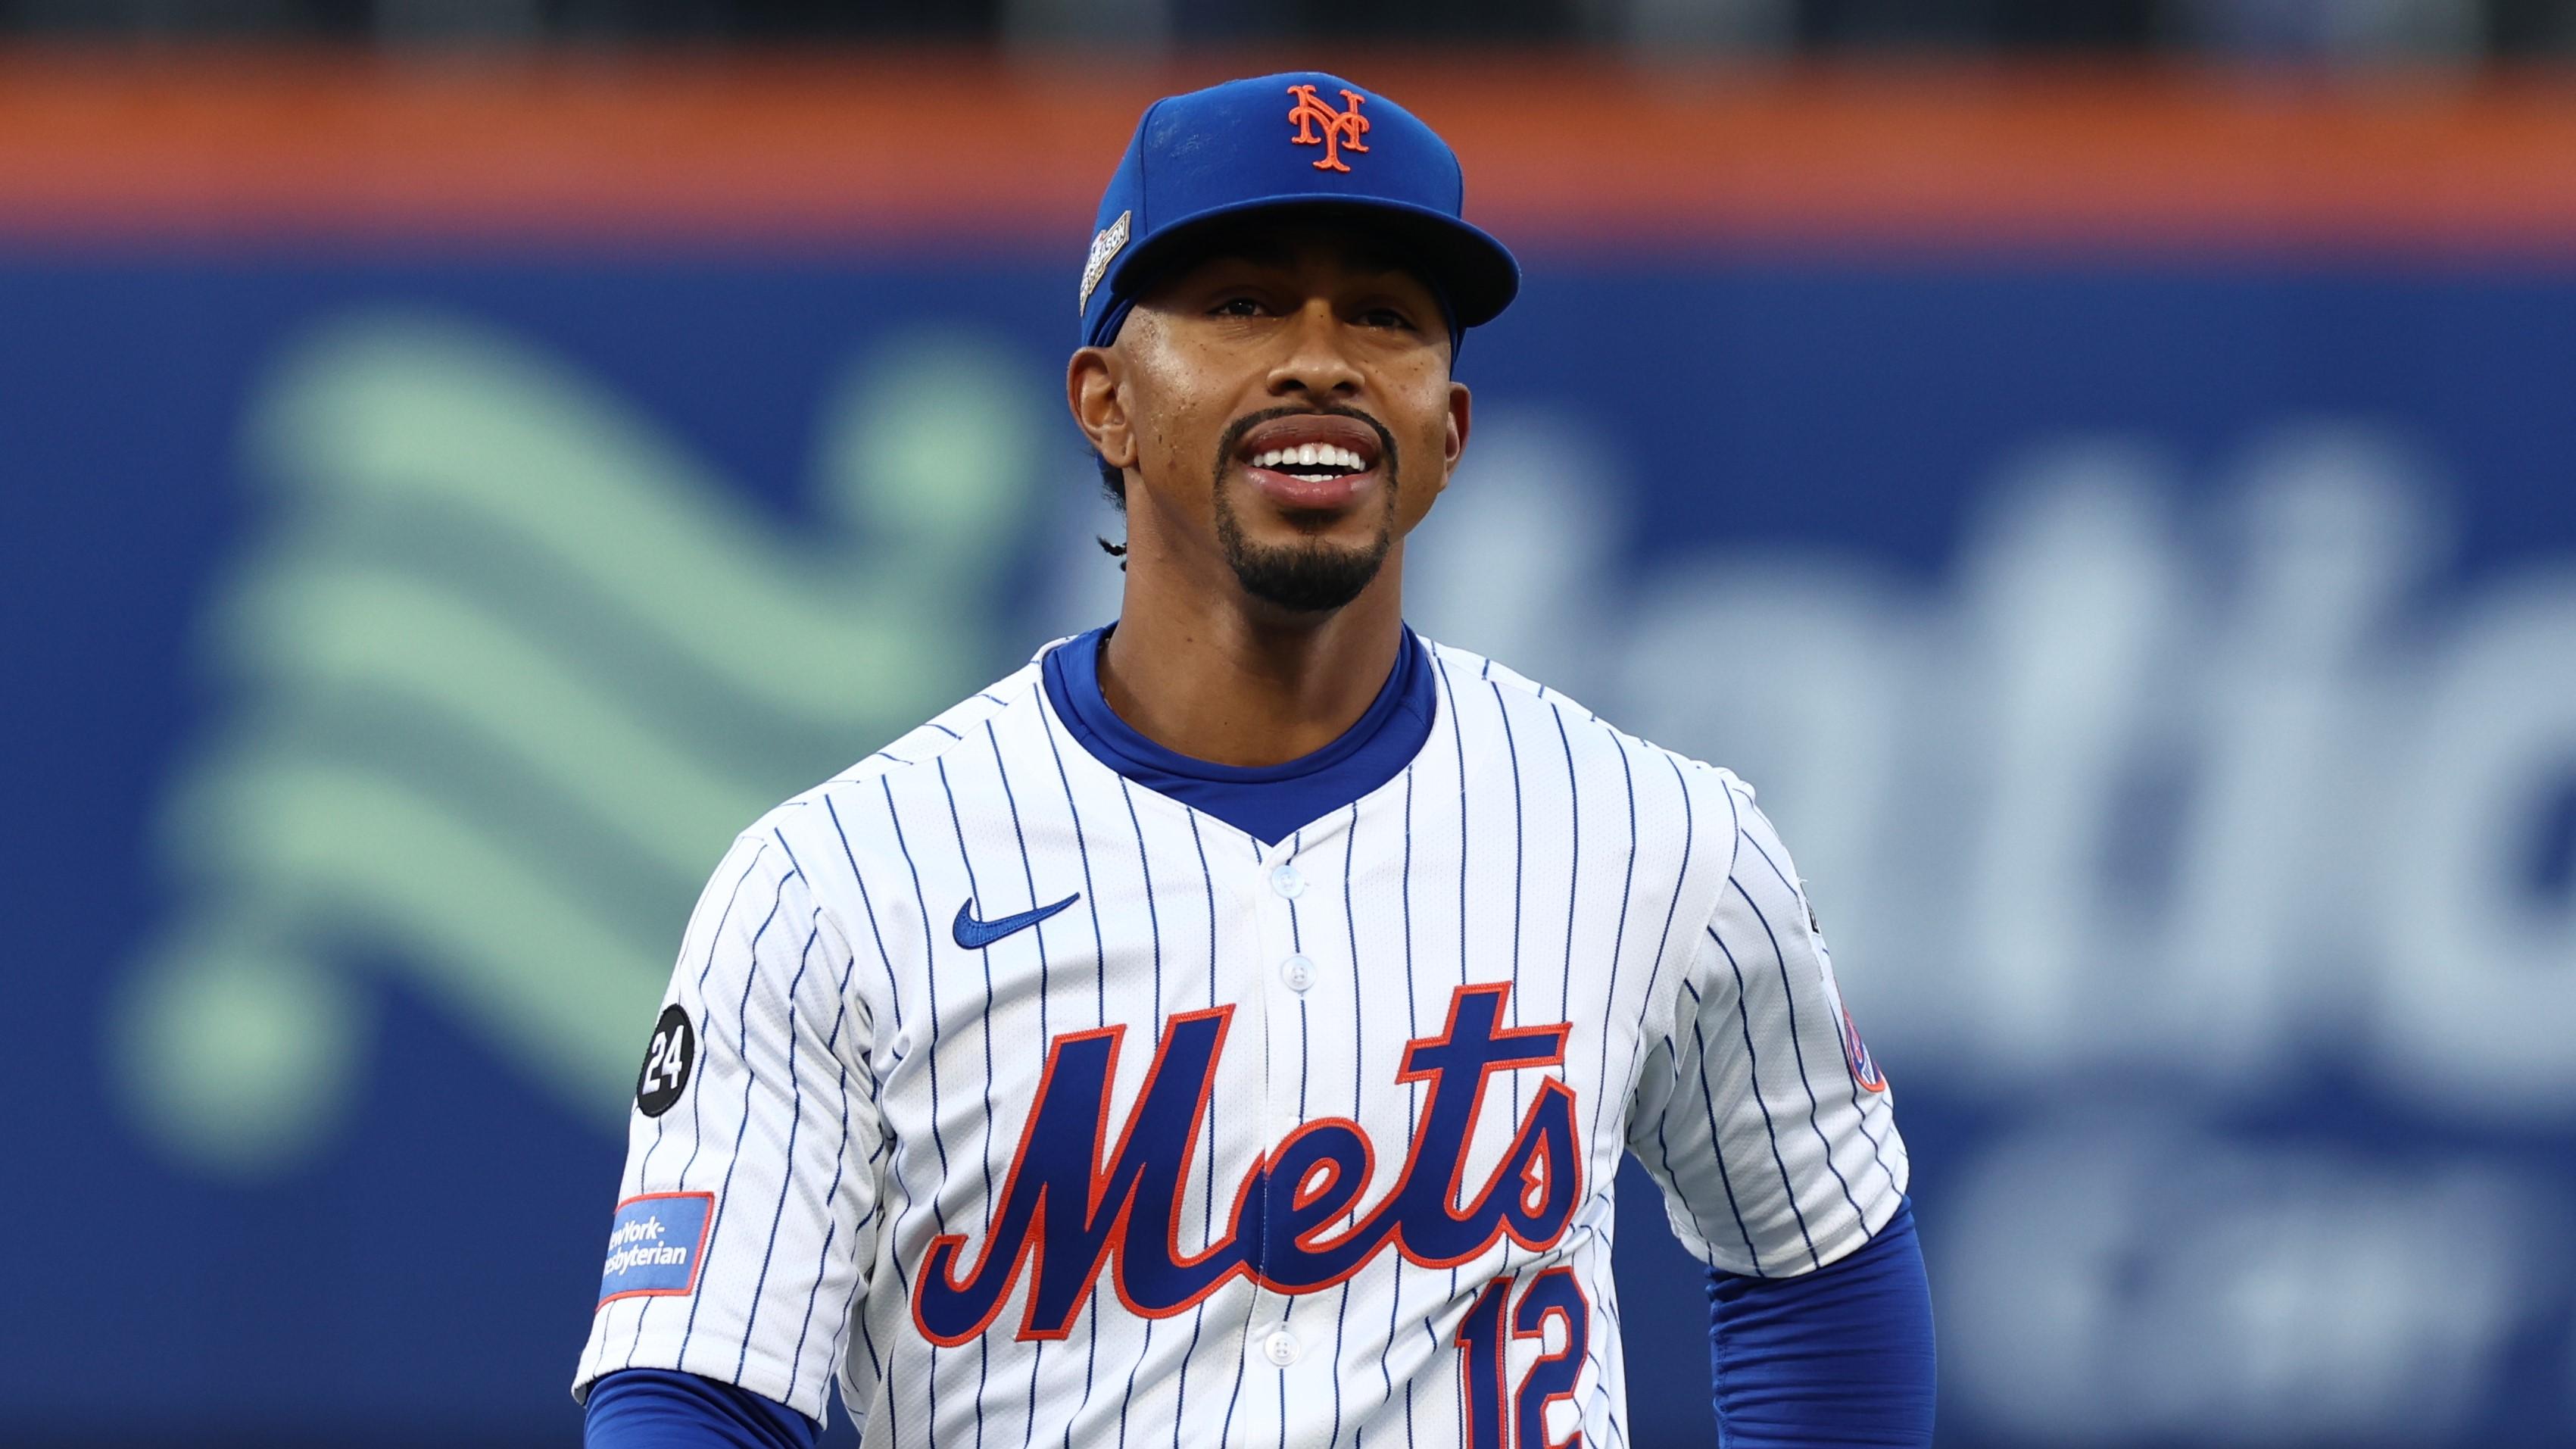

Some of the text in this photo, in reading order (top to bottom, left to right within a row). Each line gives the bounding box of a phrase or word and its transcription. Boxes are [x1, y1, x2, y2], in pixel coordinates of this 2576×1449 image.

[1287, 84, 1369, 173] NY
[642, 1024, 685, 1095] 24
[912, 980, 1583, 1349] Mets
[605, 1240, 687, 1276] esbyterian
[609, 1215, 665, 1251] ewYork-
[1454, 1266, 1589, 1449] 12
